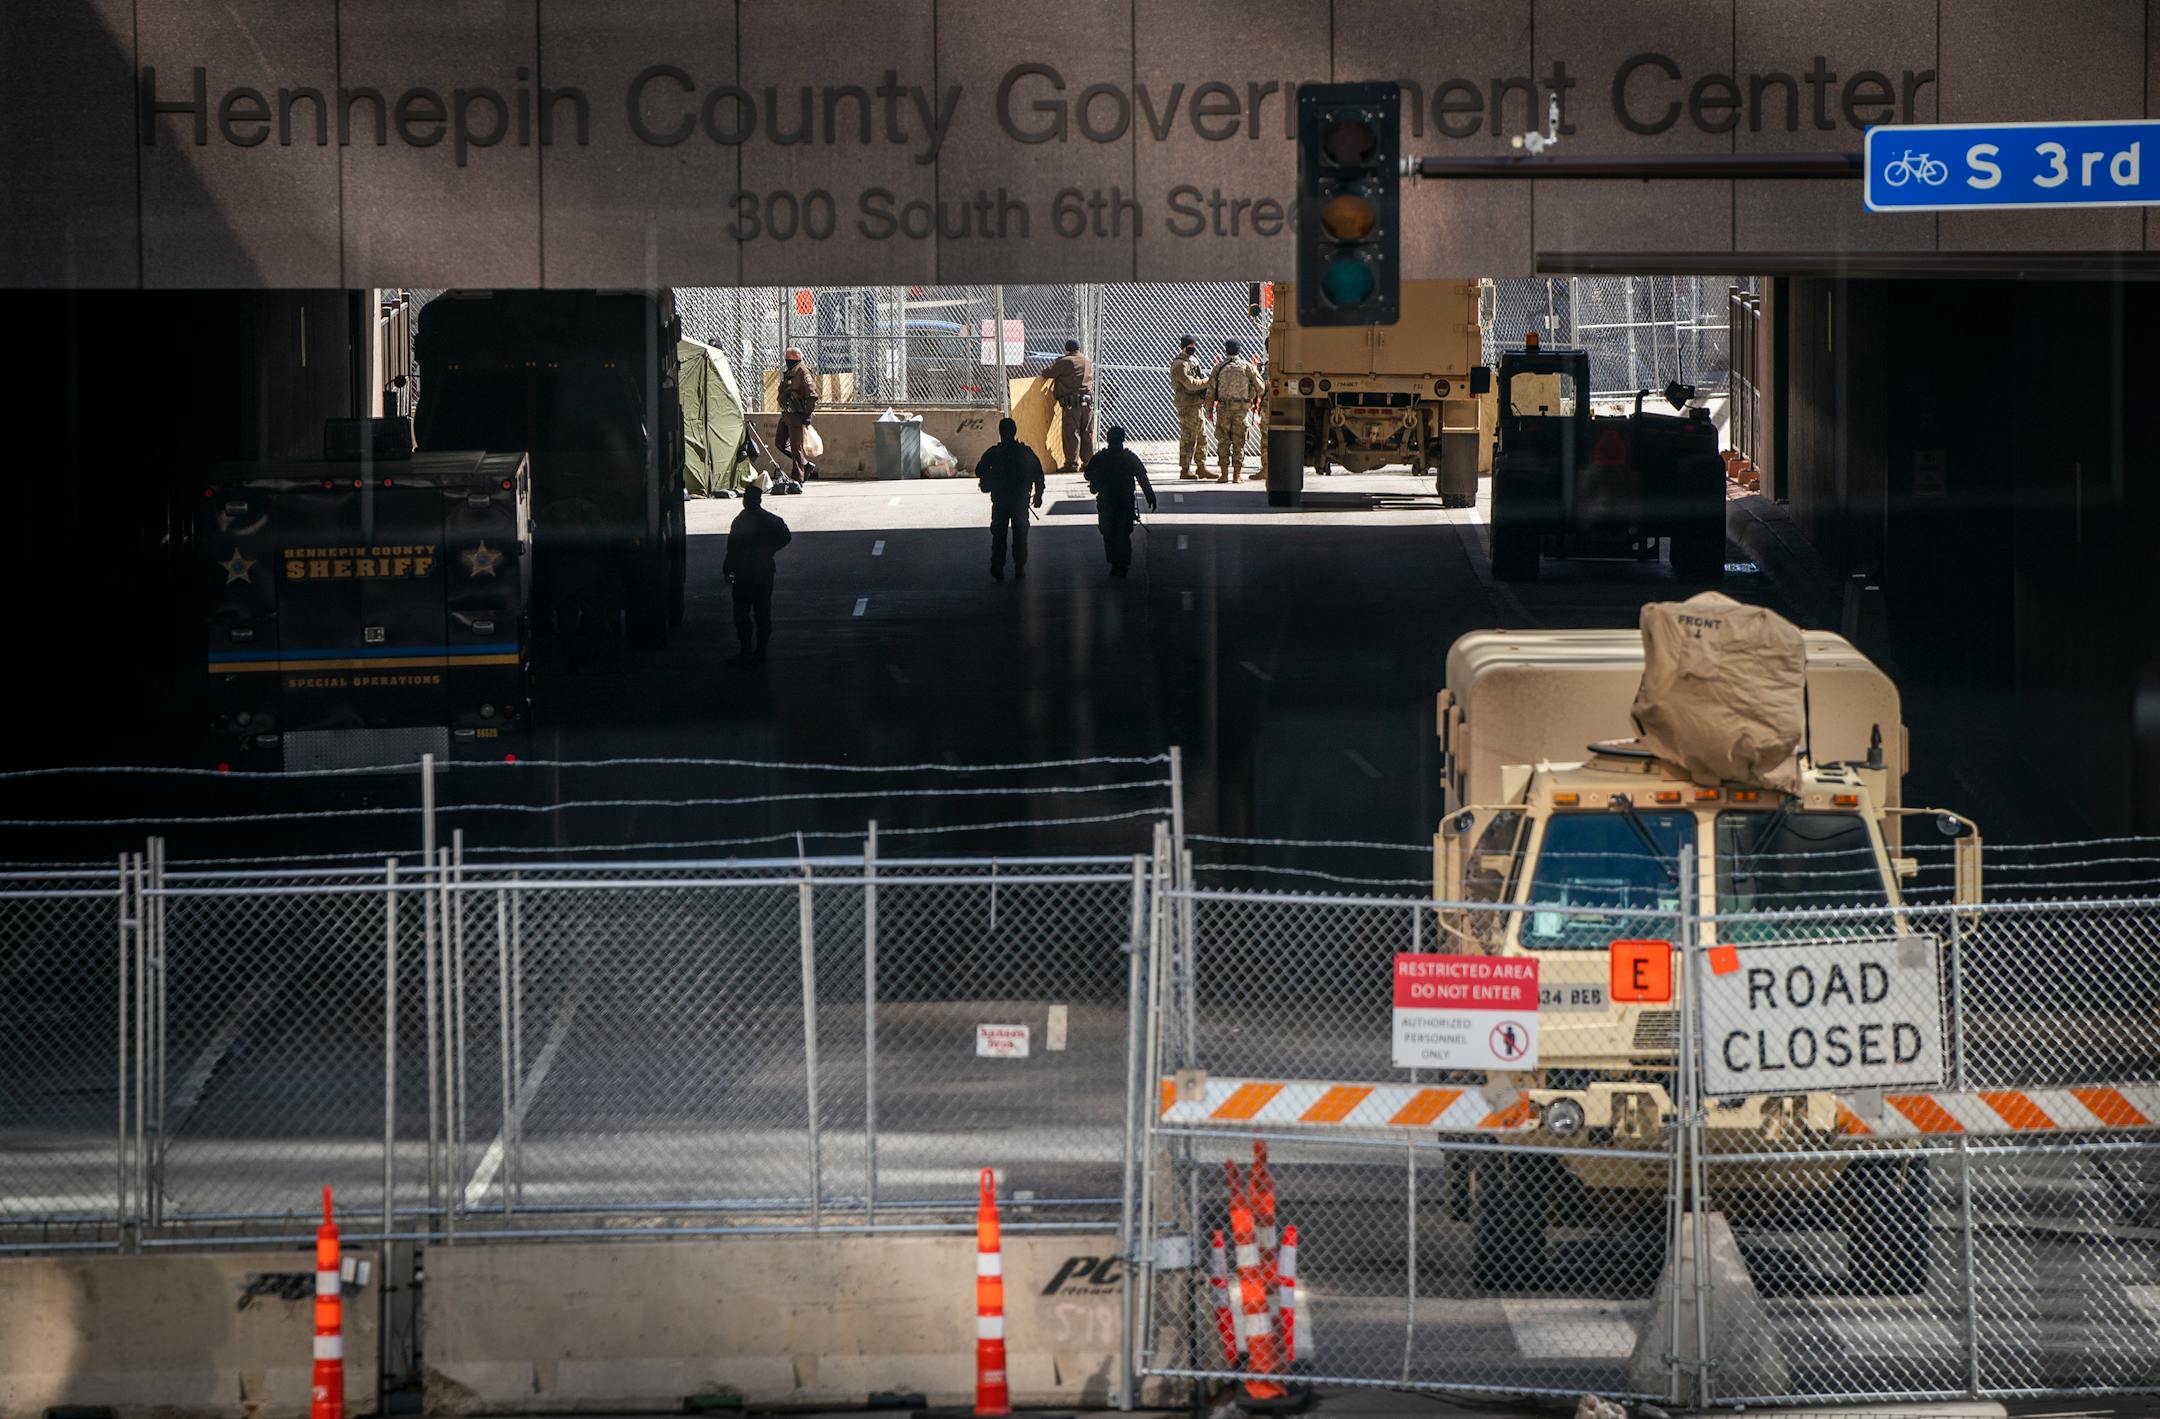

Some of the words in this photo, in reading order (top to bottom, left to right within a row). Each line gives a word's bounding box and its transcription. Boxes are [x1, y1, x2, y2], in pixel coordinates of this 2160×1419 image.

[141, 66, 590, 168] Hennepin
[626, 64, 963, 166] County
[1611, 51, 1936, 135] Center
[1966, 143, 2002, 190] S
[2032, 141, 2141, 188] 3rd
[726, 188, 837, 242] 300
[857, 186, 1031, 241] South
[1051, 186, 1143, 239] 6th
[284, 548, 367, 559] HENNEPIN
[371, 545, 436, 557] COUNTY
[286, 557, 433, 579] SHERIFF
[1677, 614, 1722, 630] FRONT
[288, 677, 348, 688] SPECIAL
[353, 675, 441, 687] OPERATIONS
[1398, 961, 1491, 979] RESTRICTED
[1493, 964, 1535, 980] AREA
[1632, 958, 1649, 990] E
[1410, 982, 1435, 998] DO
[1437, 984, 1470, 1000] NOT
[1472, 985, 1521, 1001] ENTER
[1749, 961, 1890, 1010] ROAD
[1401, 1017, 1472, 1030] AUTHORIZED
[1404, 1033, 1468, 1045] PERSONNEL
[1722, 1022, 1923, 1073] CLOSED
[1421, 1049, 1450, 1061] ONLY
